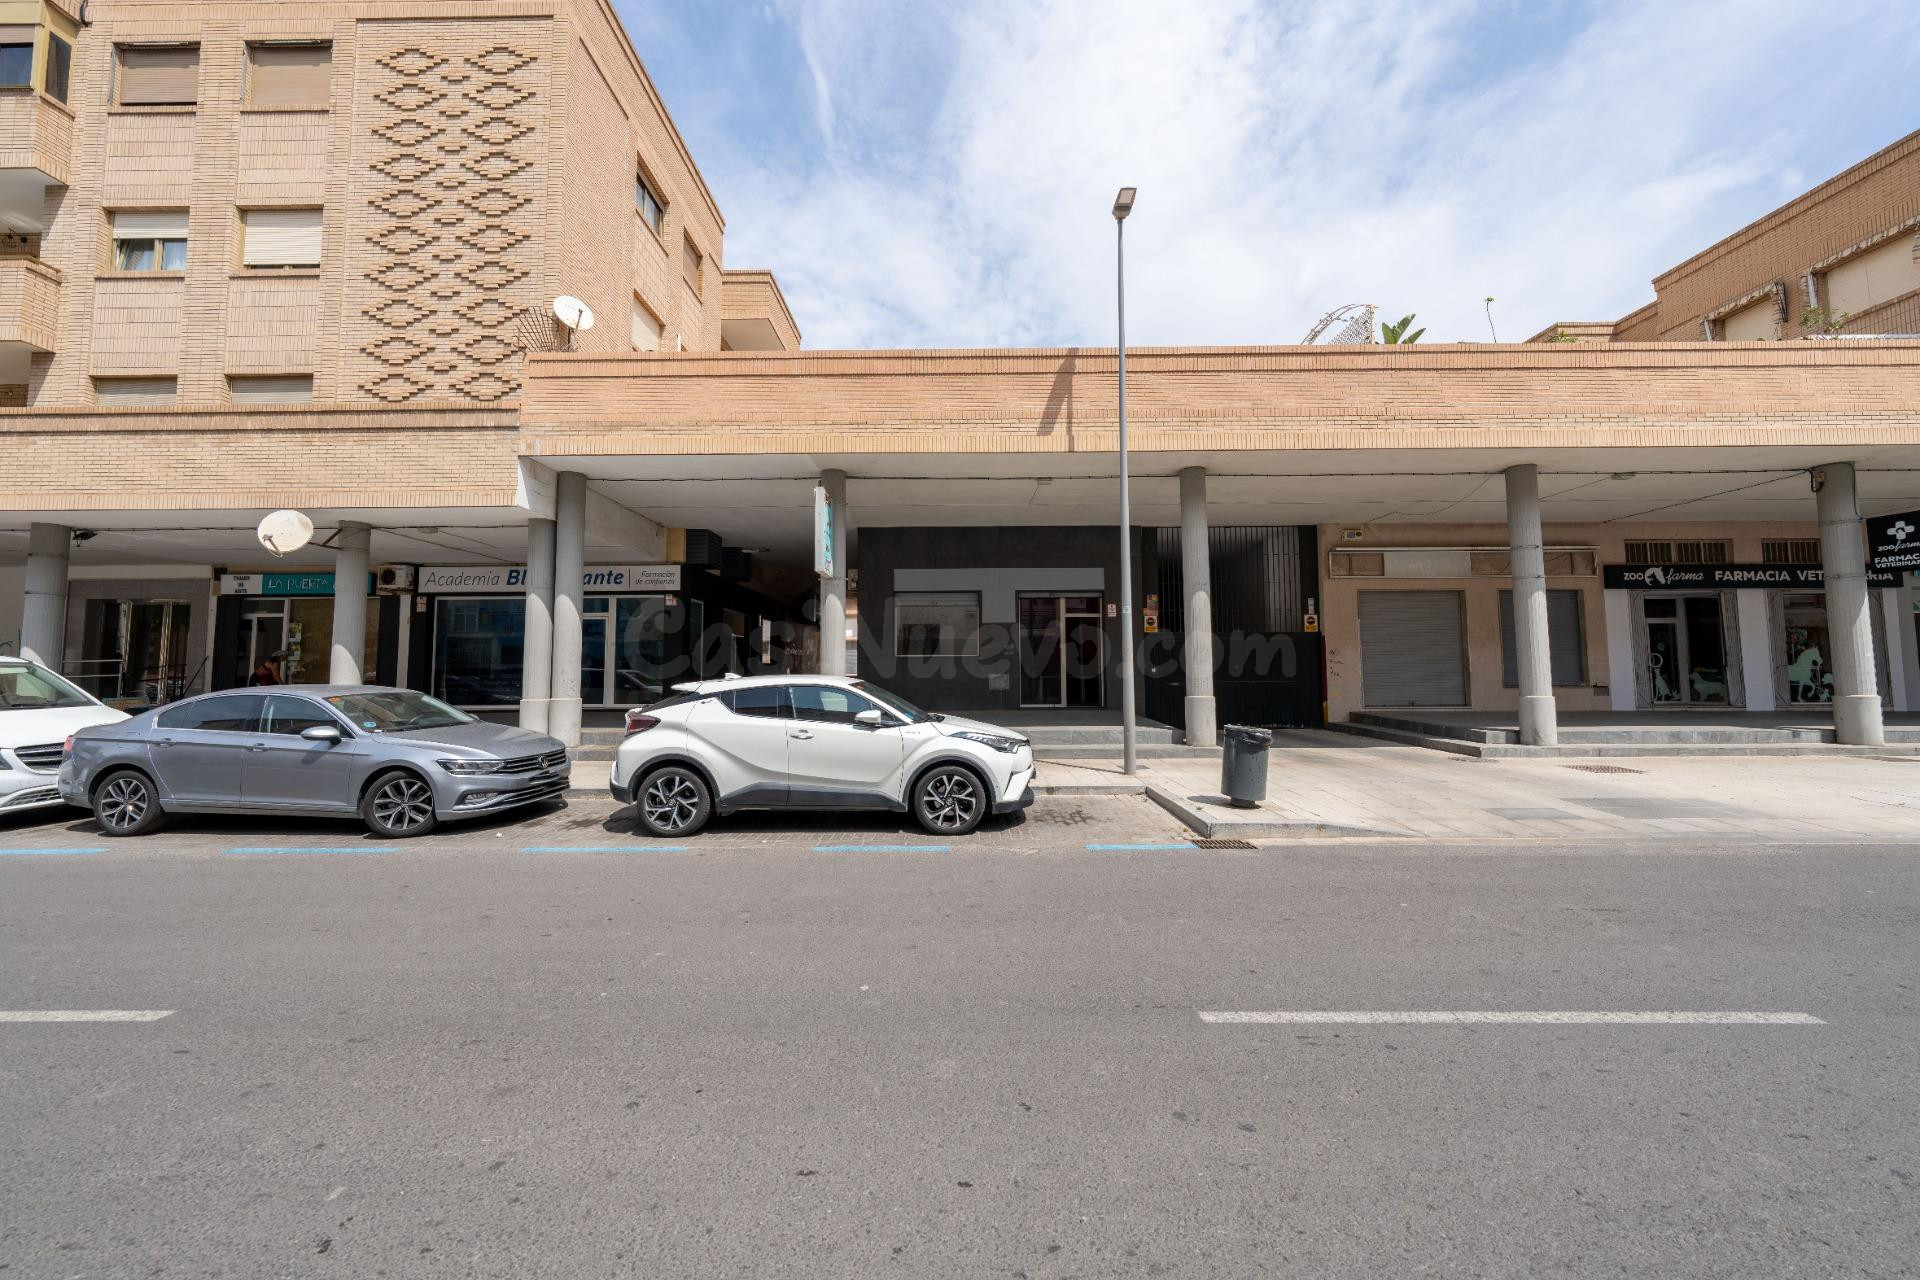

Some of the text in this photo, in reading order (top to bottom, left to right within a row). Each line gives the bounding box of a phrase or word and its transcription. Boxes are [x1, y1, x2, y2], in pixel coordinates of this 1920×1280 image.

[424, 571, 500, 587] Academia
[644, 578, 676, 586] confianza
[1665, 567, 1704, 584] farma
[1715, 570, 1790, 581] FARMACIA
[287, 577, 329, 590] PUERTA
